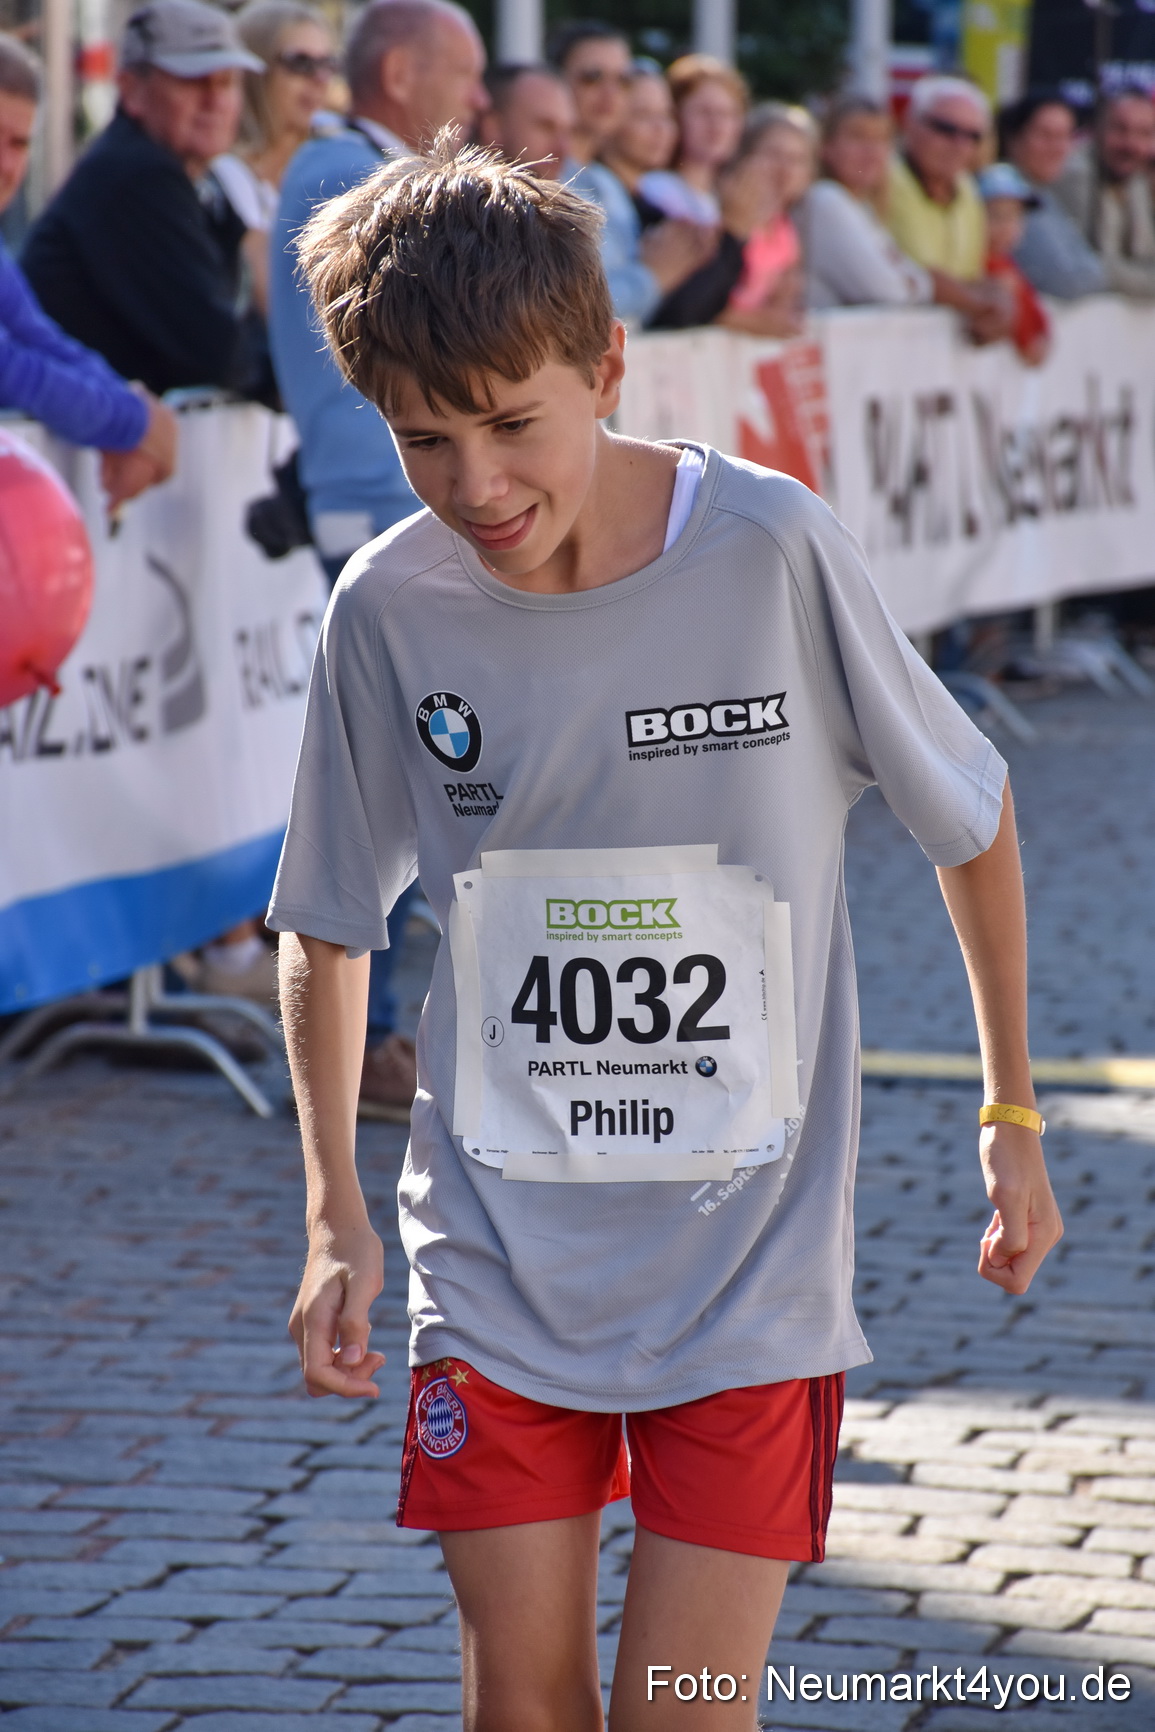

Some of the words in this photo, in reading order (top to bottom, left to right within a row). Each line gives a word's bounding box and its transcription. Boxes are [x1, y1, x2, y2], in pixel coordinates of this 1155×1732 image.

[418, 694, 472, 722] BMW
[626, 693, 787, 746] BOCK
[628, 744, 680, 761] inspired
[683, 742, 699, 756] by
[702, 740, 739, 753] smart
[743, 731, 791, 750] concepts
[443, 782, 504, 802] PARTL
[546, 899, 680, 928] BOCK
[546, 931, 584, 942] inspired
[587, 932, 599, 943] by
[602, 932, 632, 941] smart
[635, 931, 683, 942] concepts
[511, 953, 731, 1045] 4032
[528, 1061, 592, 1076] PARTL
[597, 1059, 689, 1076] Neumarkt
[570, 1099, 675, 1144] Philip
[697, 1198, 722, 1217] 16.
